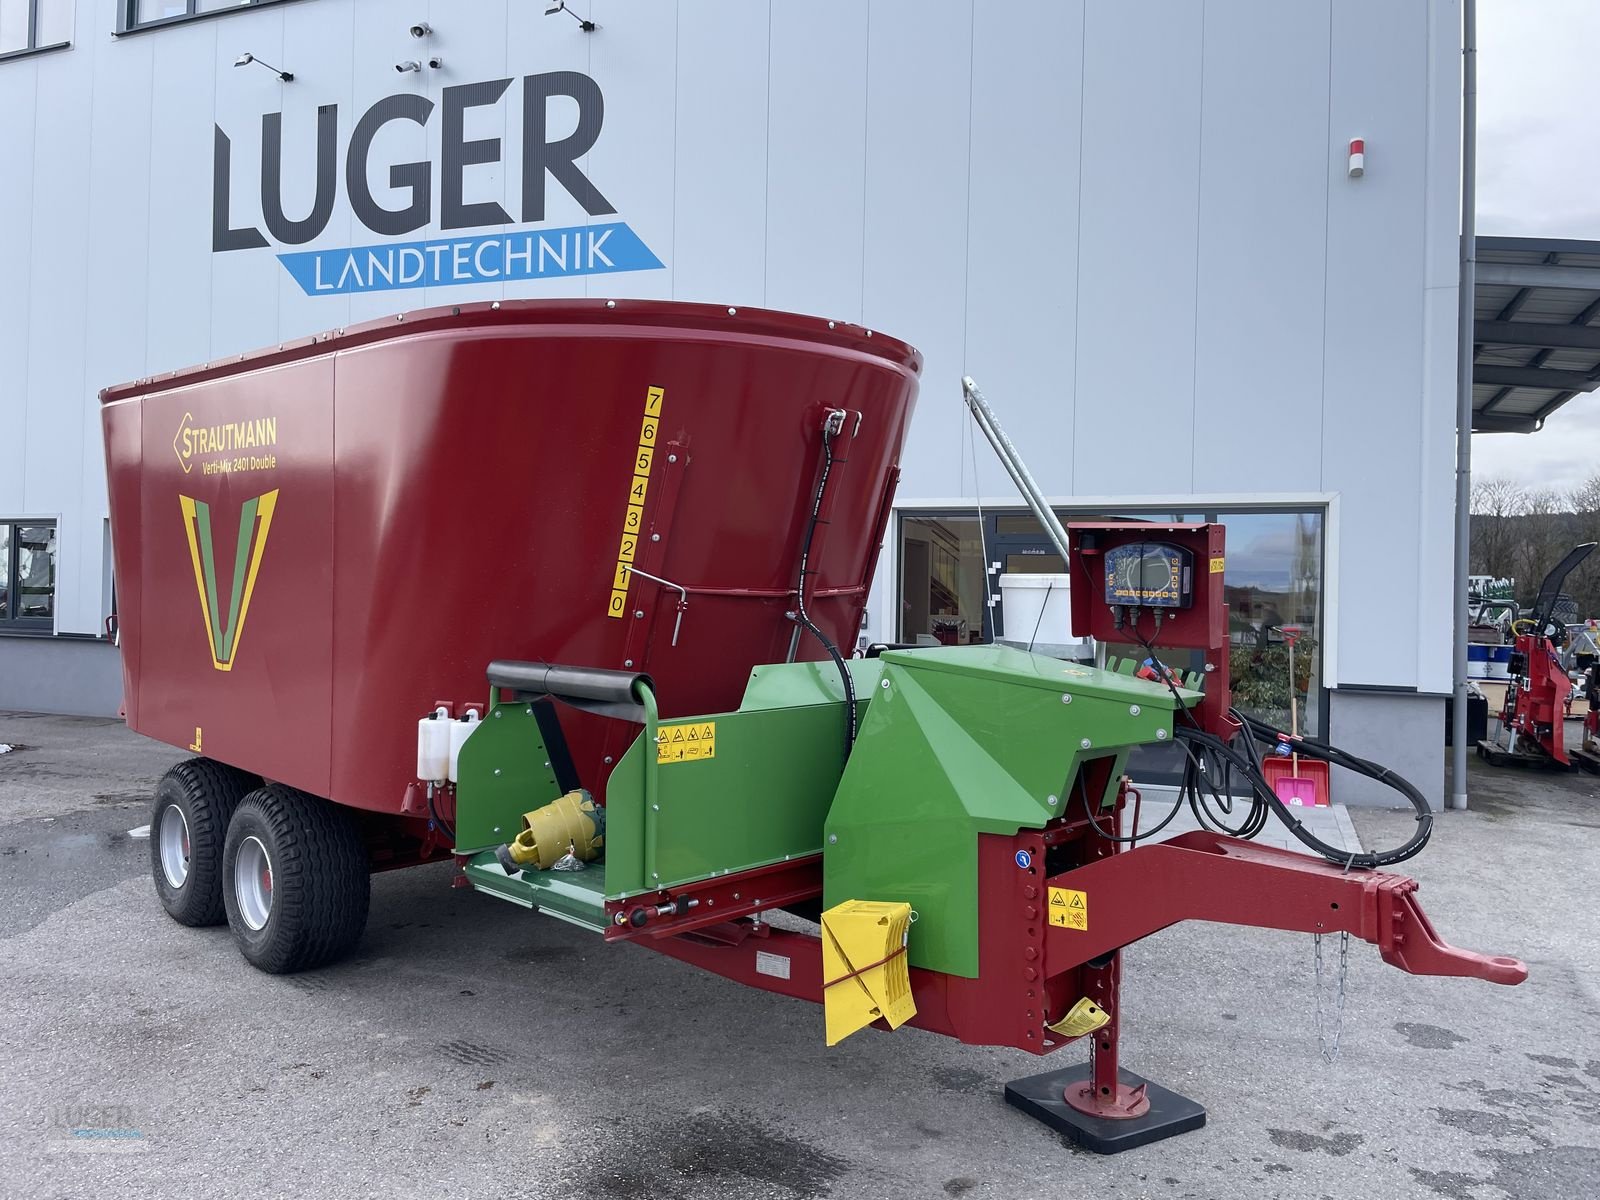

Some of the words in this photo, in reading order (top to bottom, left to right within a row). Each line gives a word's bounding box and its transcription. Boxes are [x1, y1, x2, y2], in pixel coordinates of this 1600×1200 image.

[213, 71, 619, 252] LUGER
[315, 230, 616, 290] LANDTECHNIK
[650, 393, 661, 409] 7
[182, 417, 277, 458] STRAUTMANN
[644, 424, 655, 439] 6
[202, 459, 232, 475] Verti-Mix
[233, 457, 249, 472] 2401
[250, 453, 276, 470] Double
[638, 453, 649, 469] 5
[632, 483, 643, 498] 4
[627, 512, 638, 527] 3
[622, 540, 633, 555] 2
[612, 596, 623, 611] 0
